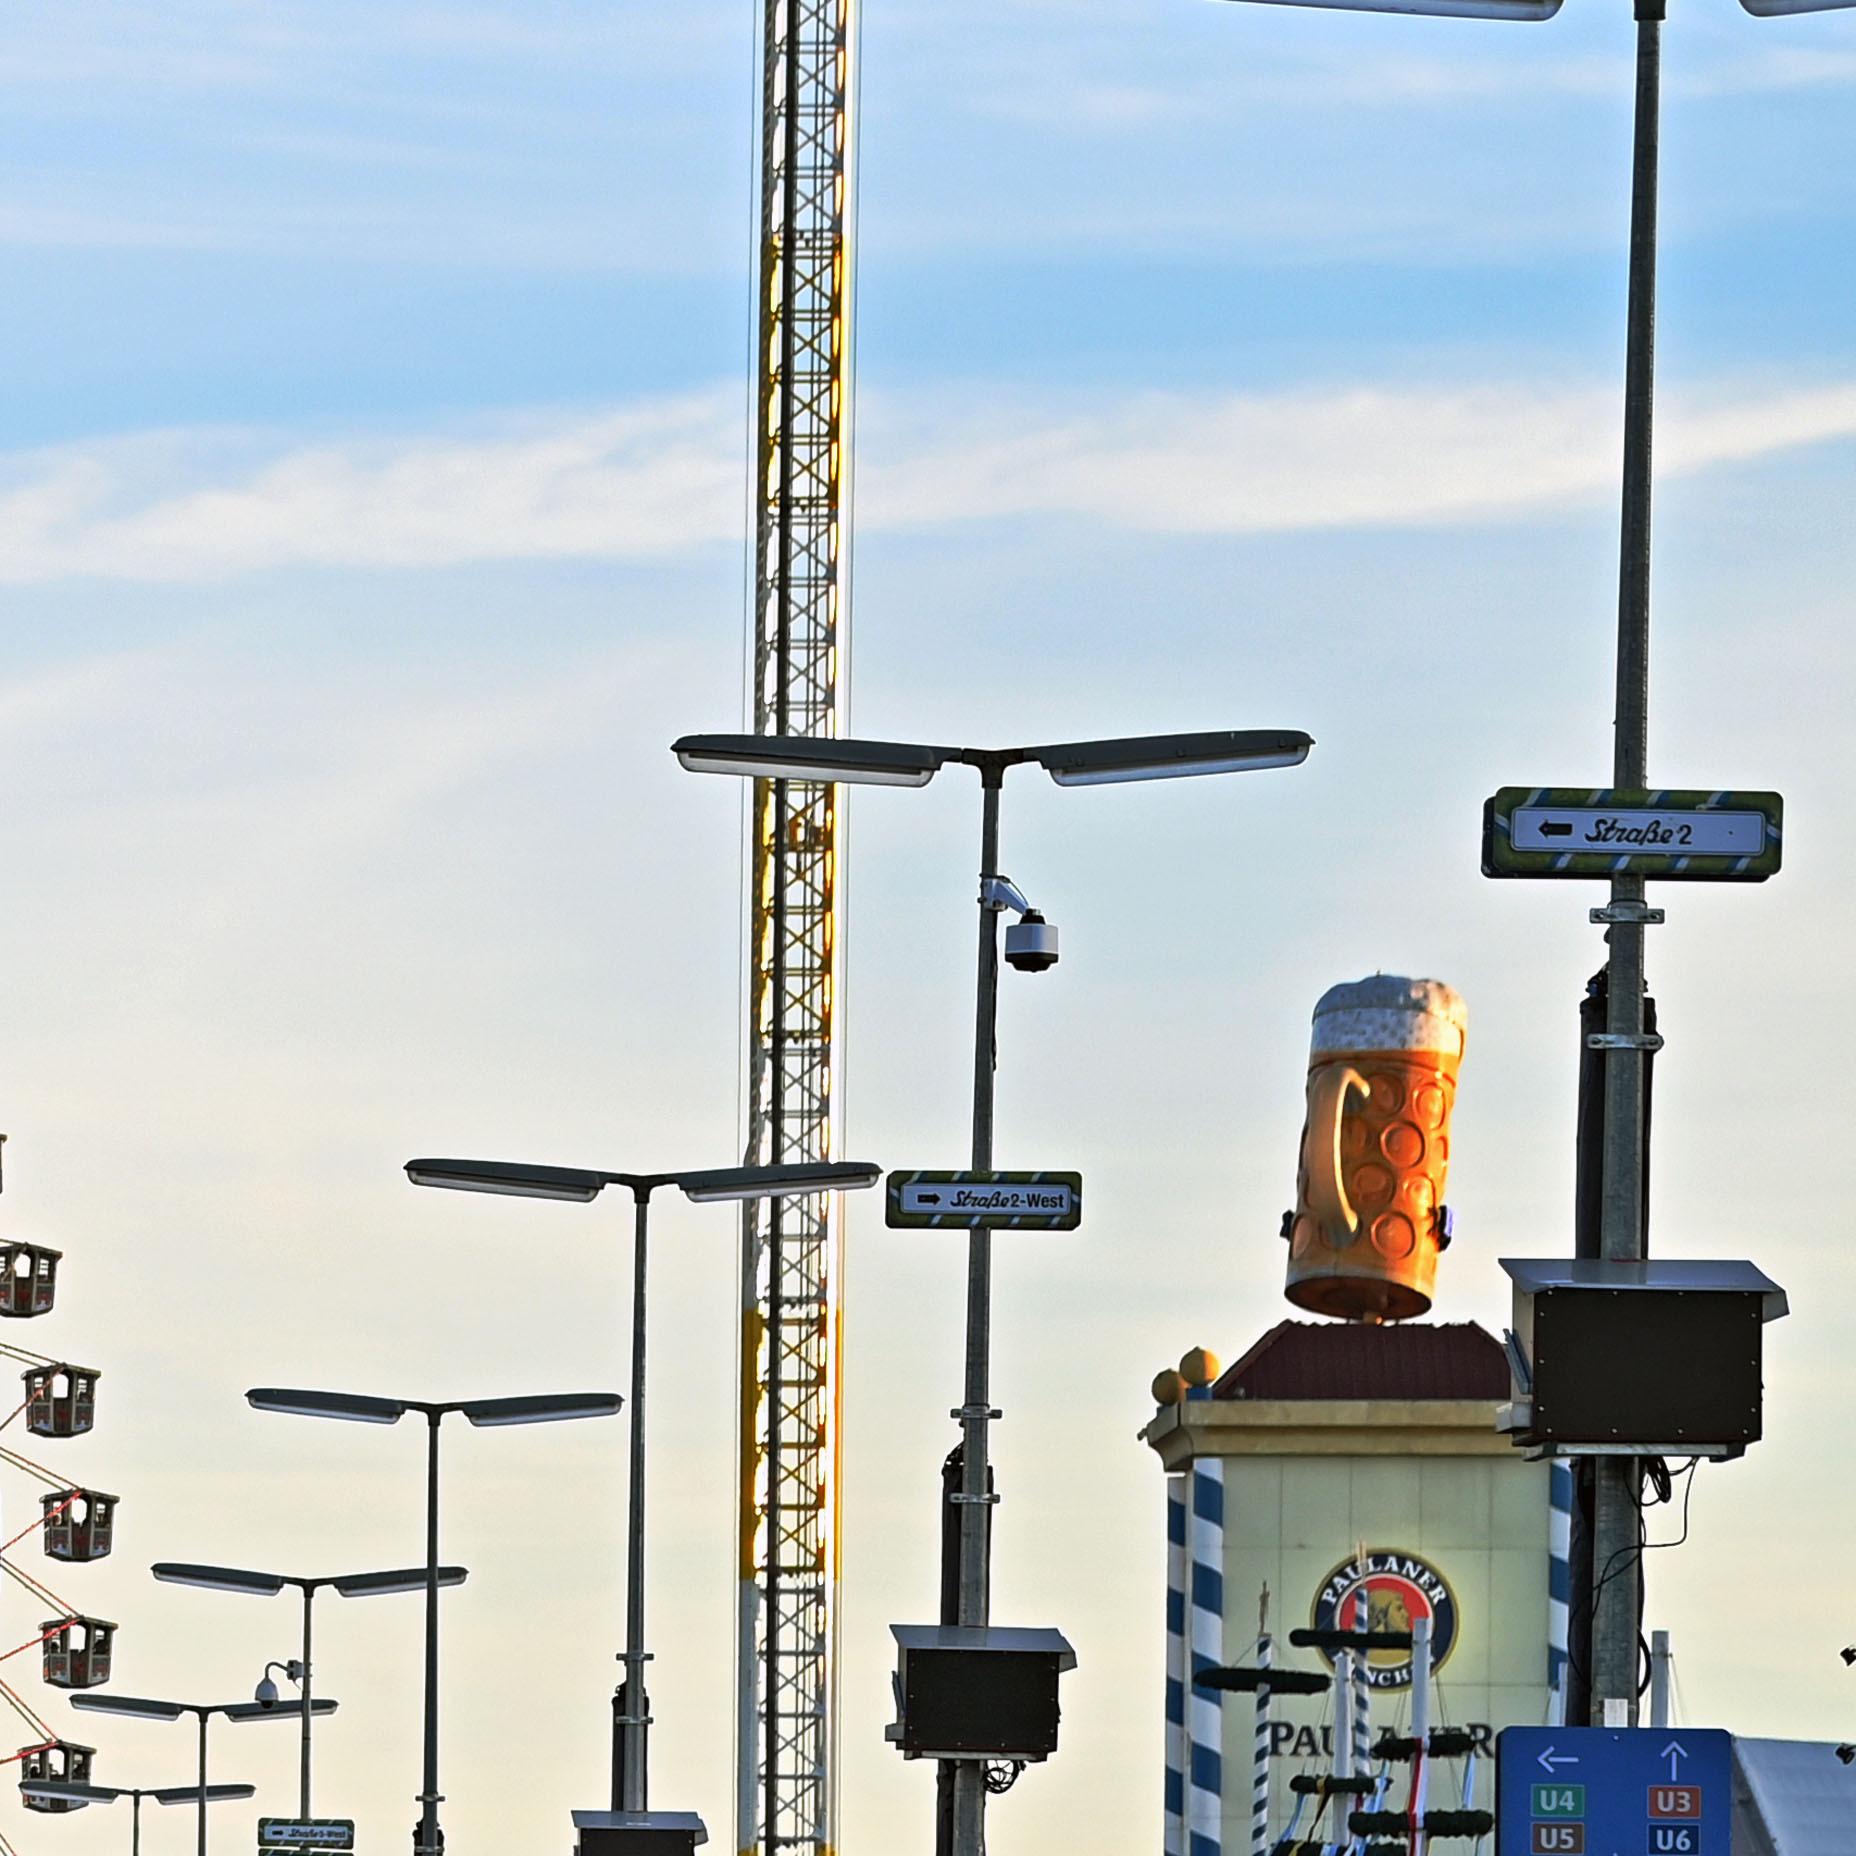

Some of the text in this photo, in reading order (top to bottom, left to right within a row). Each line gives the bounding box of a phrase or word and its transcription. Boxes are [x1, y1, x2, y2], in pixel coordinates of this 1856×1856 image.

[1584, 819, 1693, 845] Straße 2
[1322, 1555, 1448, 1605] PAULANER
[1540, 1790, 1691, 1813] U4 U3
[1540, 1828, 1691, 1851] U5 U6
